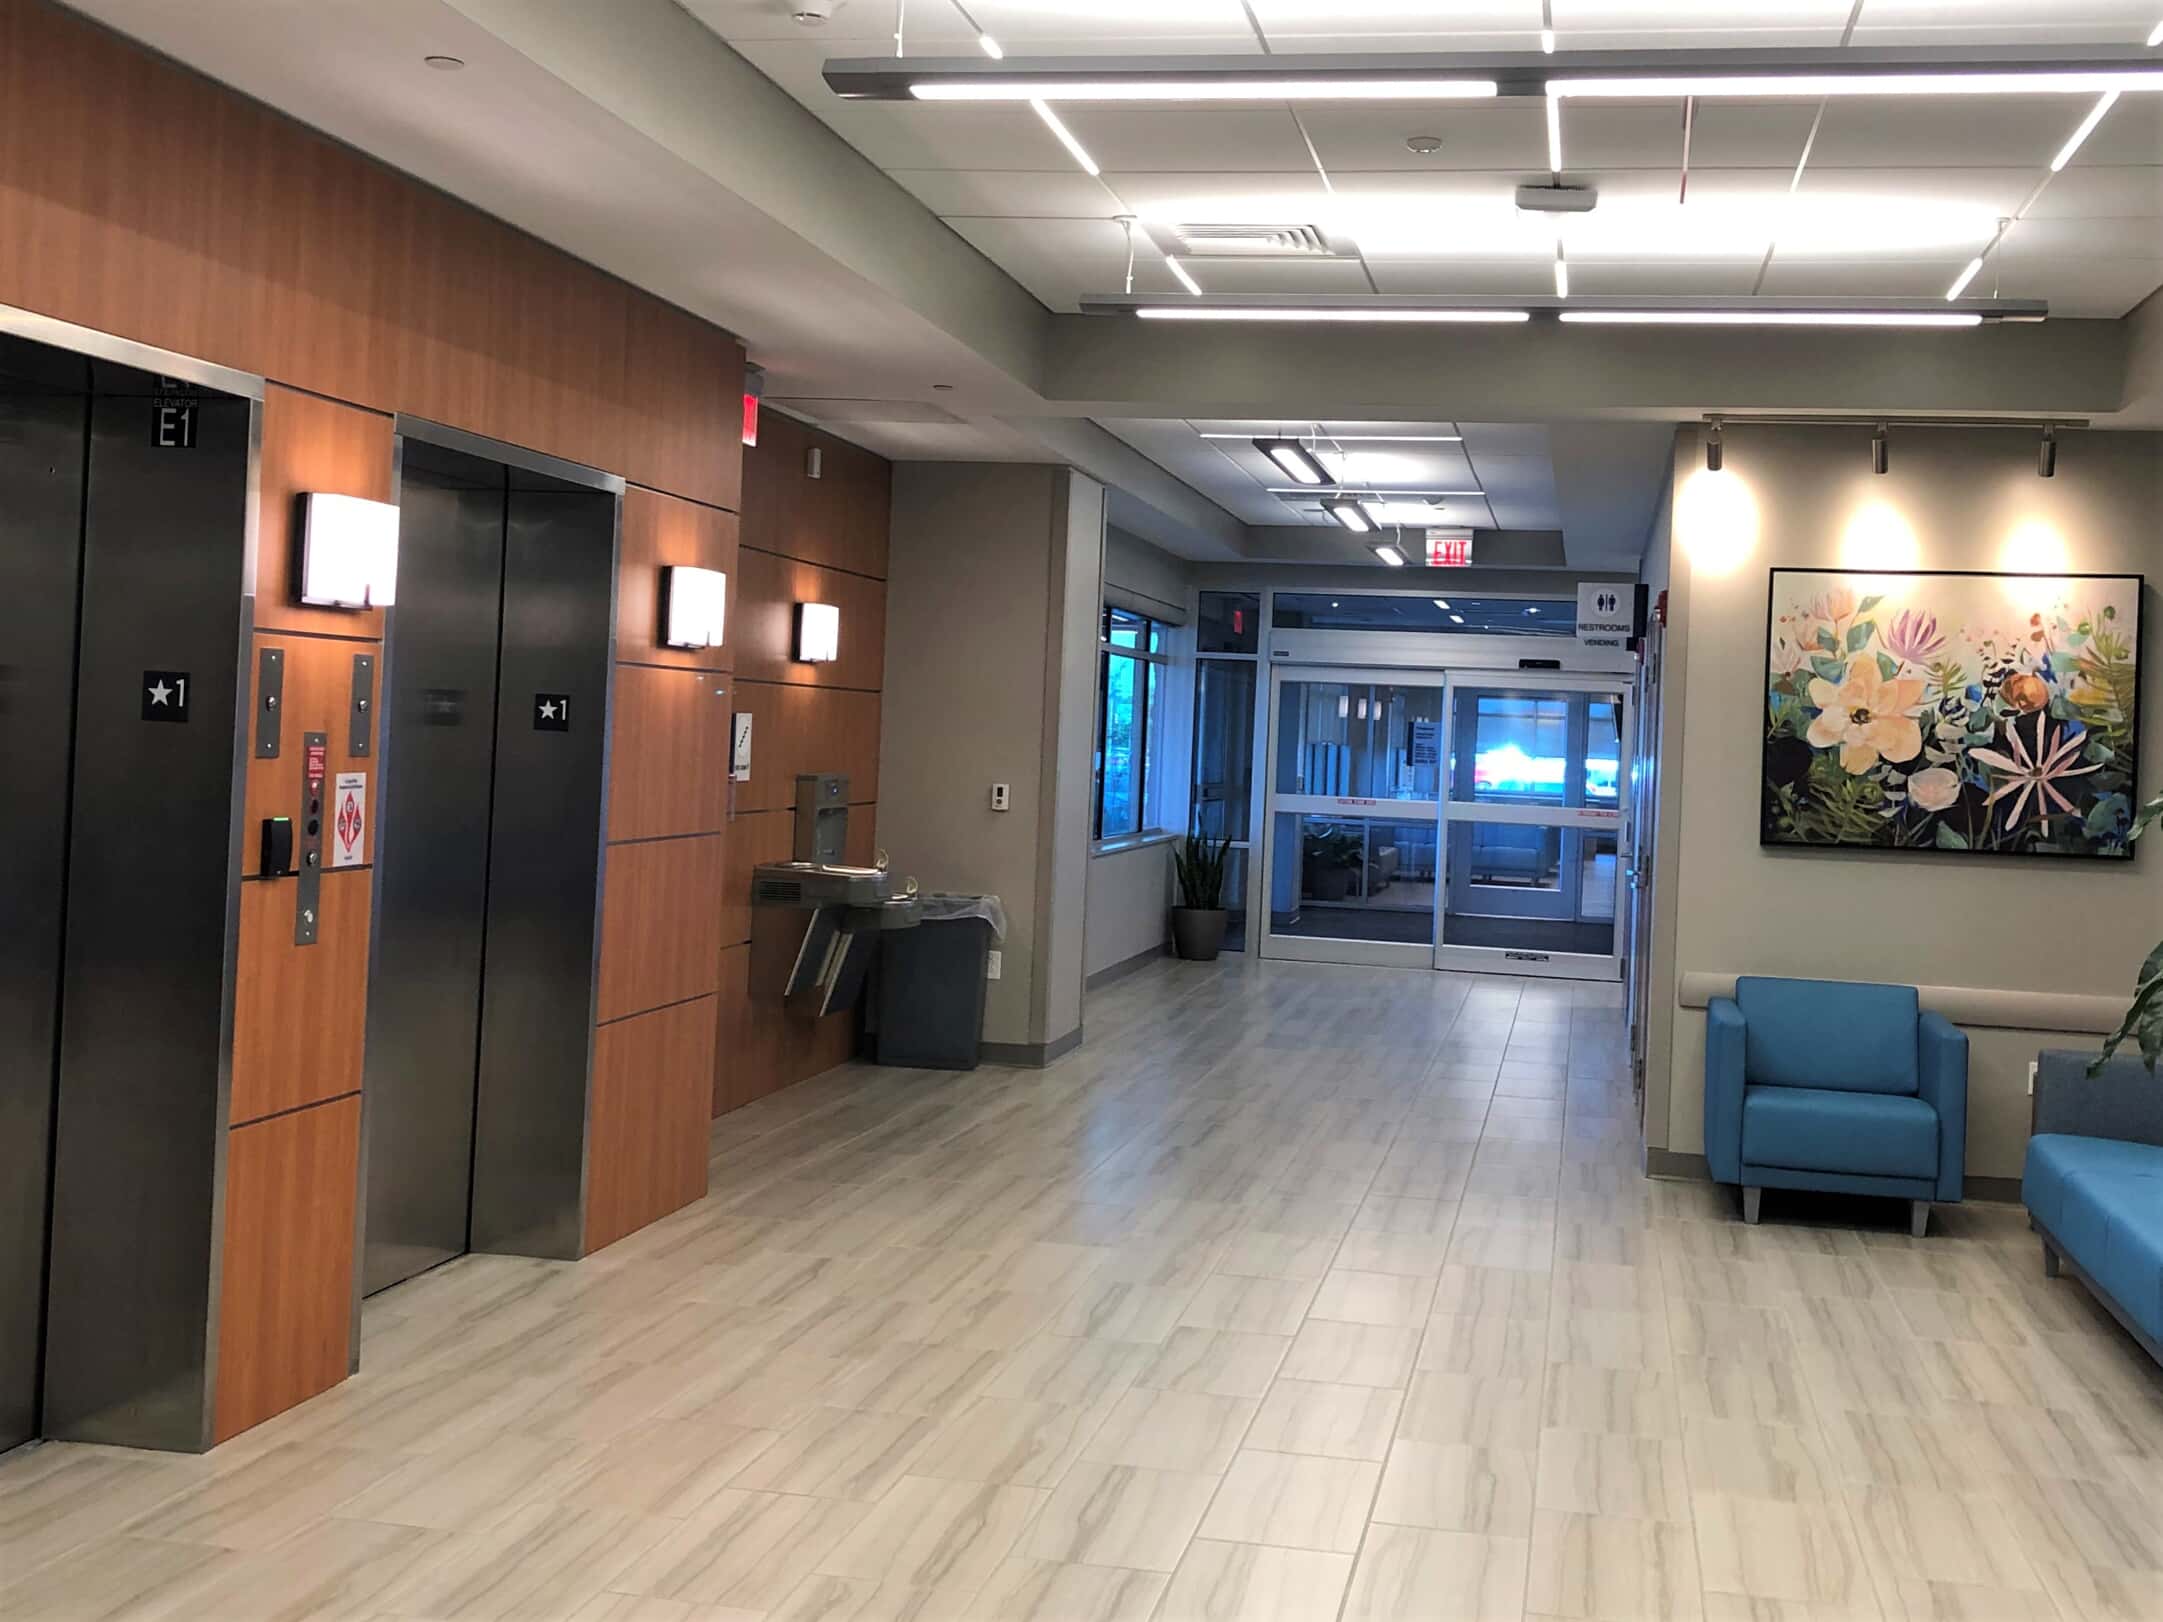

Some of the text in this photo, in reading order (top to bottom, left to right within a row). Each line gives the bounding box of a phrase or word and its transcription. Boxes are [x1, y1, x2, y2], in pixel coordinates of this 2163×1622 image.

[153, 398, 198, 408] ELEVATOR
[160, 408, 189, 446] E1
[1433, 541, 1467, 566] EXIT
[1578, 623, 1630, 632] RESTROOMS
[1584, 639, 1619, 647] VENDING
[176, 679, 184, 707] 1
[560, 700, 566, 720] 1
